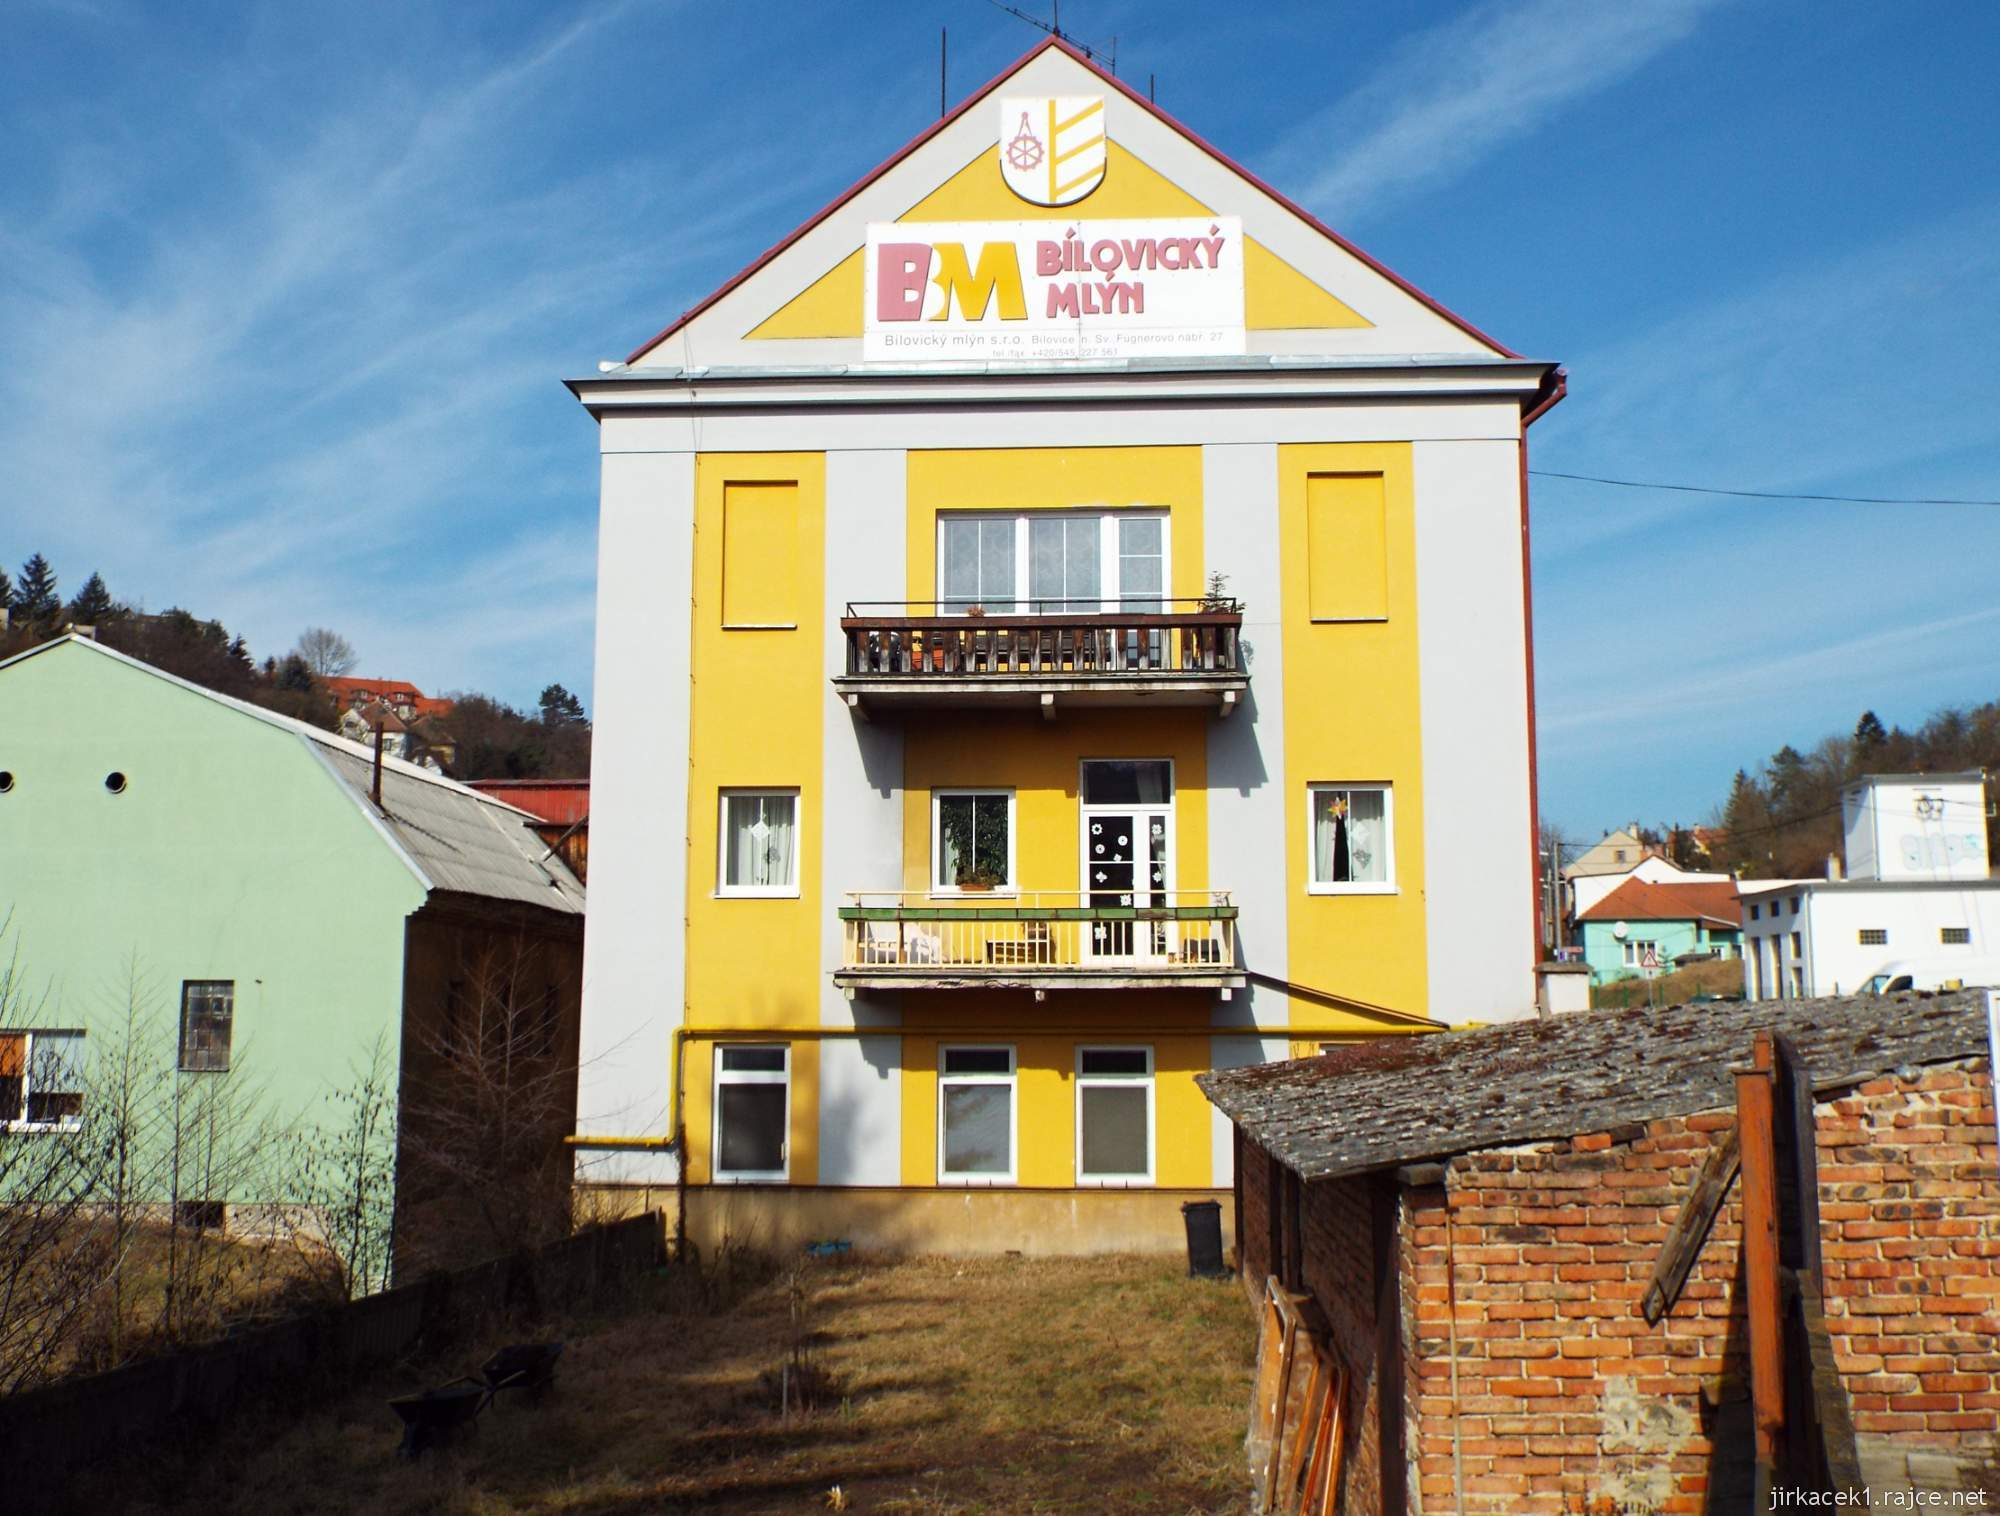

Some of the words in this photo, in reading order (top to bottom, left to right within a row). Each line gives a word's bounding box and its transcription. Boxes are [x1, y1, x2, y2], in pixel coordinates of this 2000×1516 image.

[1036, 224, 1225, 276] BÍLOVICKÝ
[877, 241, 1028, 321] BM
[1046, 270, 1144, 318] MLÝN
